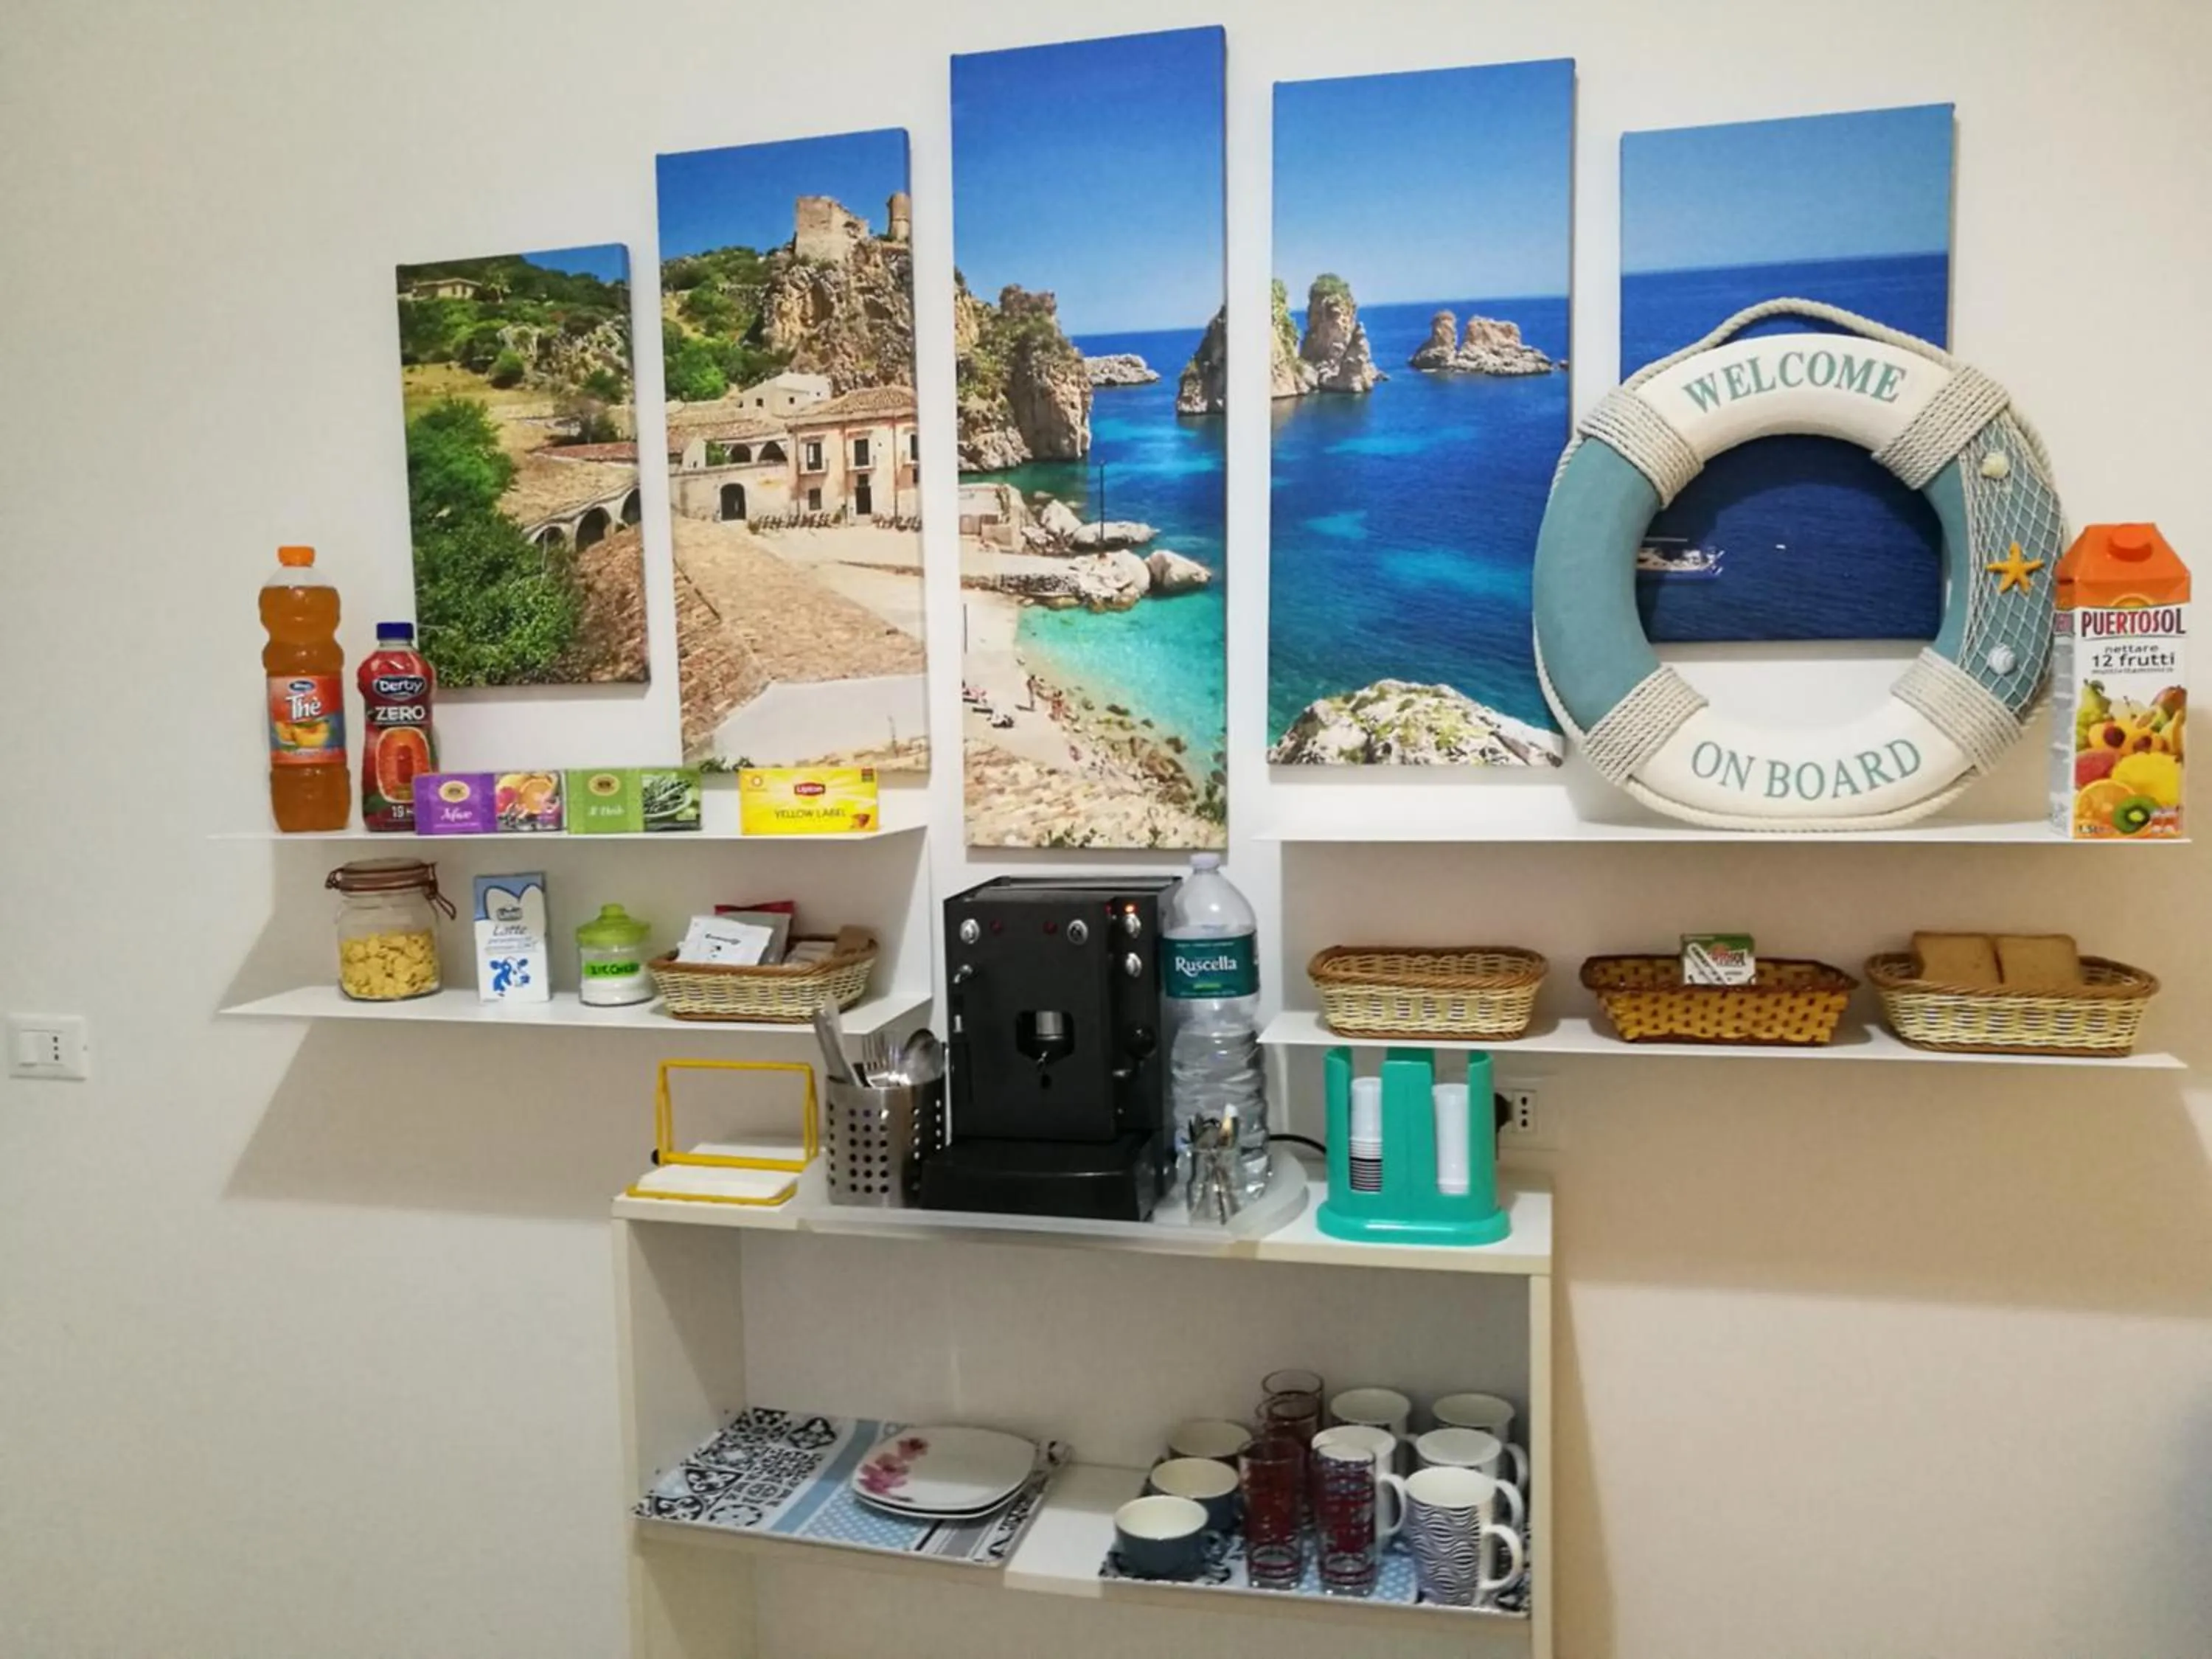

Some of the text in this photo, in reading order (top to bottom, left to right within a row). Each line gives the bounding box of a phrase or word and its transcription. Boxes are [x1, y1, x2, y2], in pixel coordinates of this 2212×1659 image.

[1682, 350, 1907, 413] WELCOME
[2081, 608, 2187, 637] PUERTOSOL
[2104, 644, 2159, 653] nettare
[2092, 653, 2175, 667] 12 frutti
[379, 680, 423, 692] Derby
[375, 706, 425, 721] ZERO
[1691, 738, 1921, 801] ON BOARD
[775, 808, 846, 820] YELLOW LABEL
[1175, 955, 1238, 977] Ruscella
